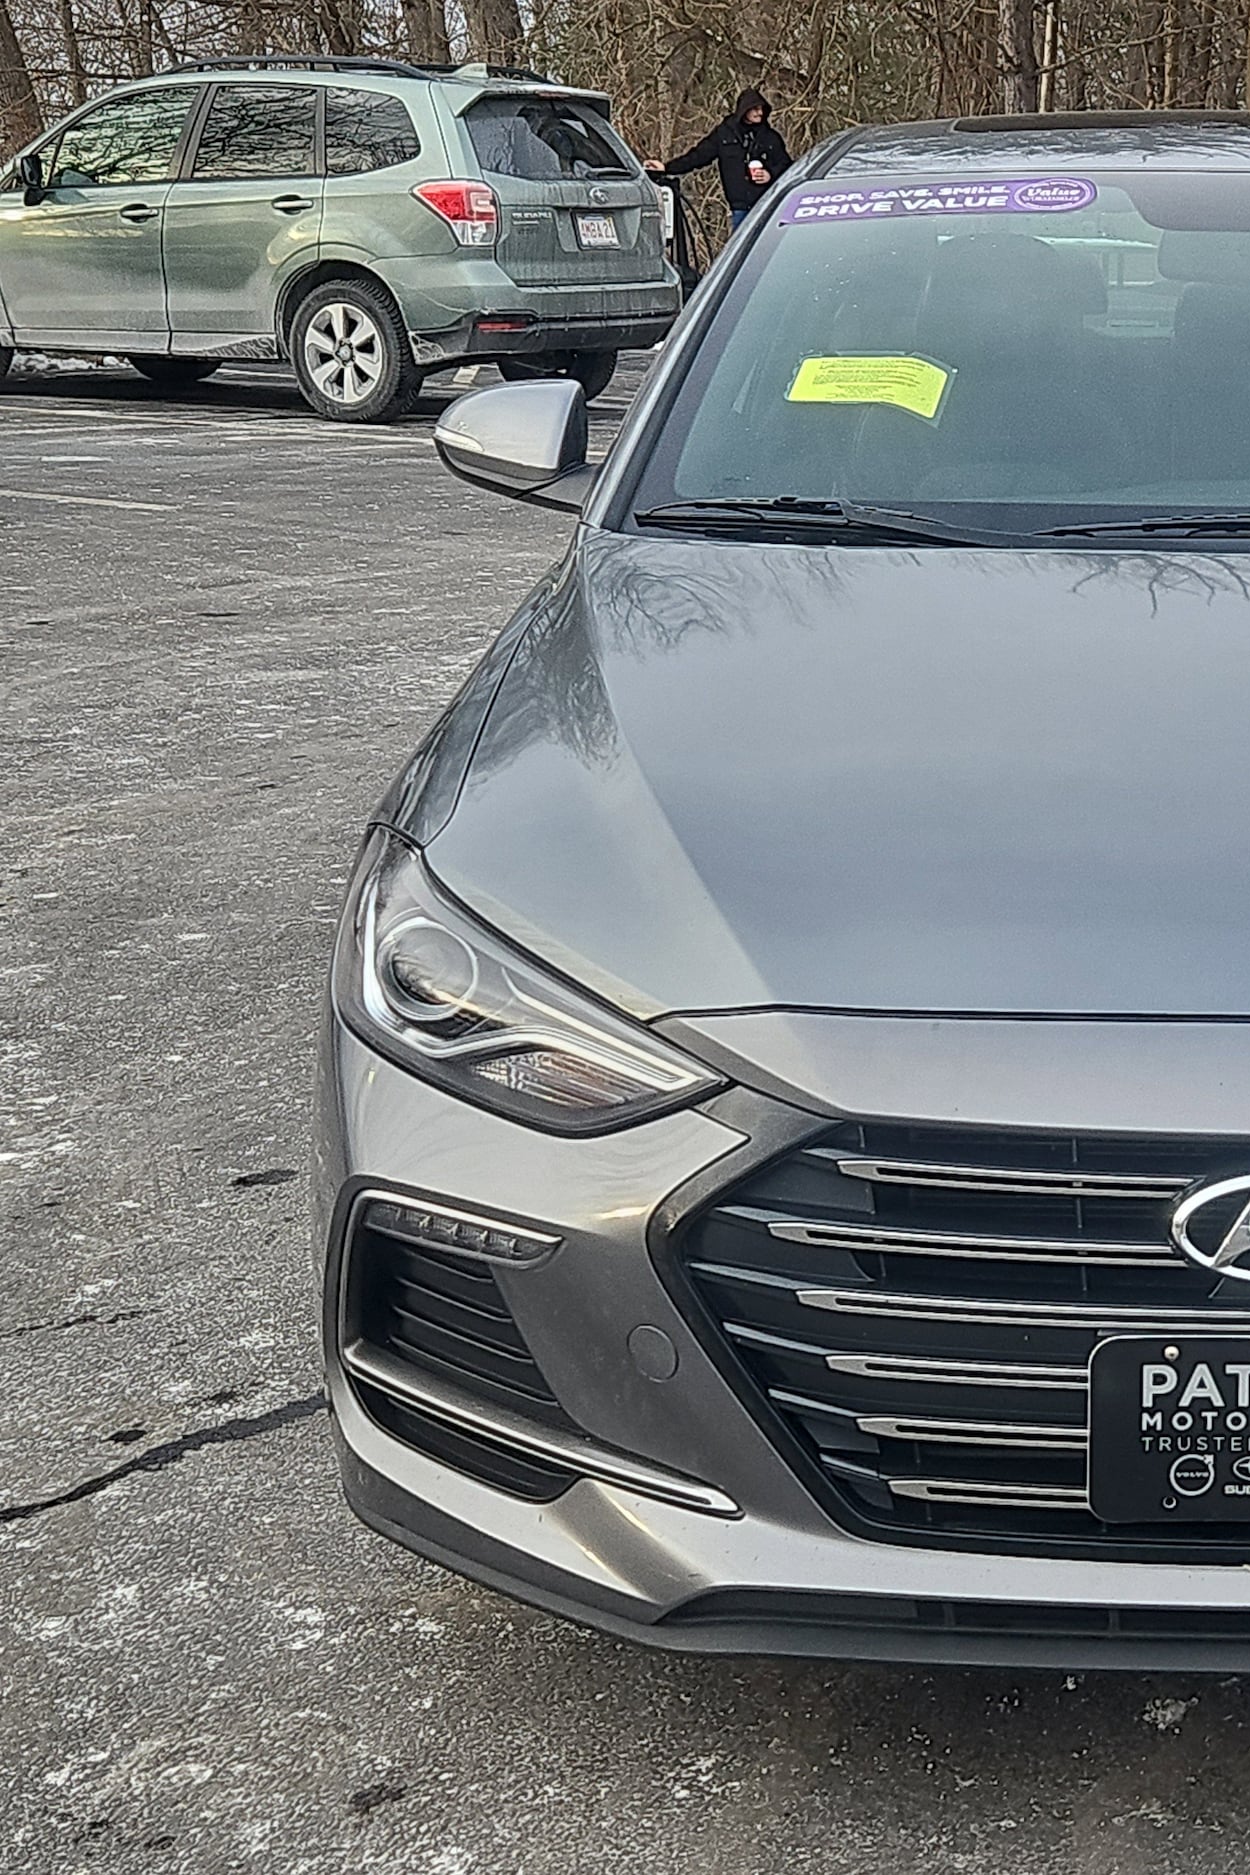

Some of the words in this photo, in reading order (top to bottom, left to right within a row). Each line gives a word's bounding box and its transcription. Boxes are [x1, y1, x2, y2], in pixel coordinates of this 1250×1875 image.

[1027, 187, 1080, 196] Value
[793, 200, 894, 218] DRIVE
[902, 195, 1008, 210] VALUE
